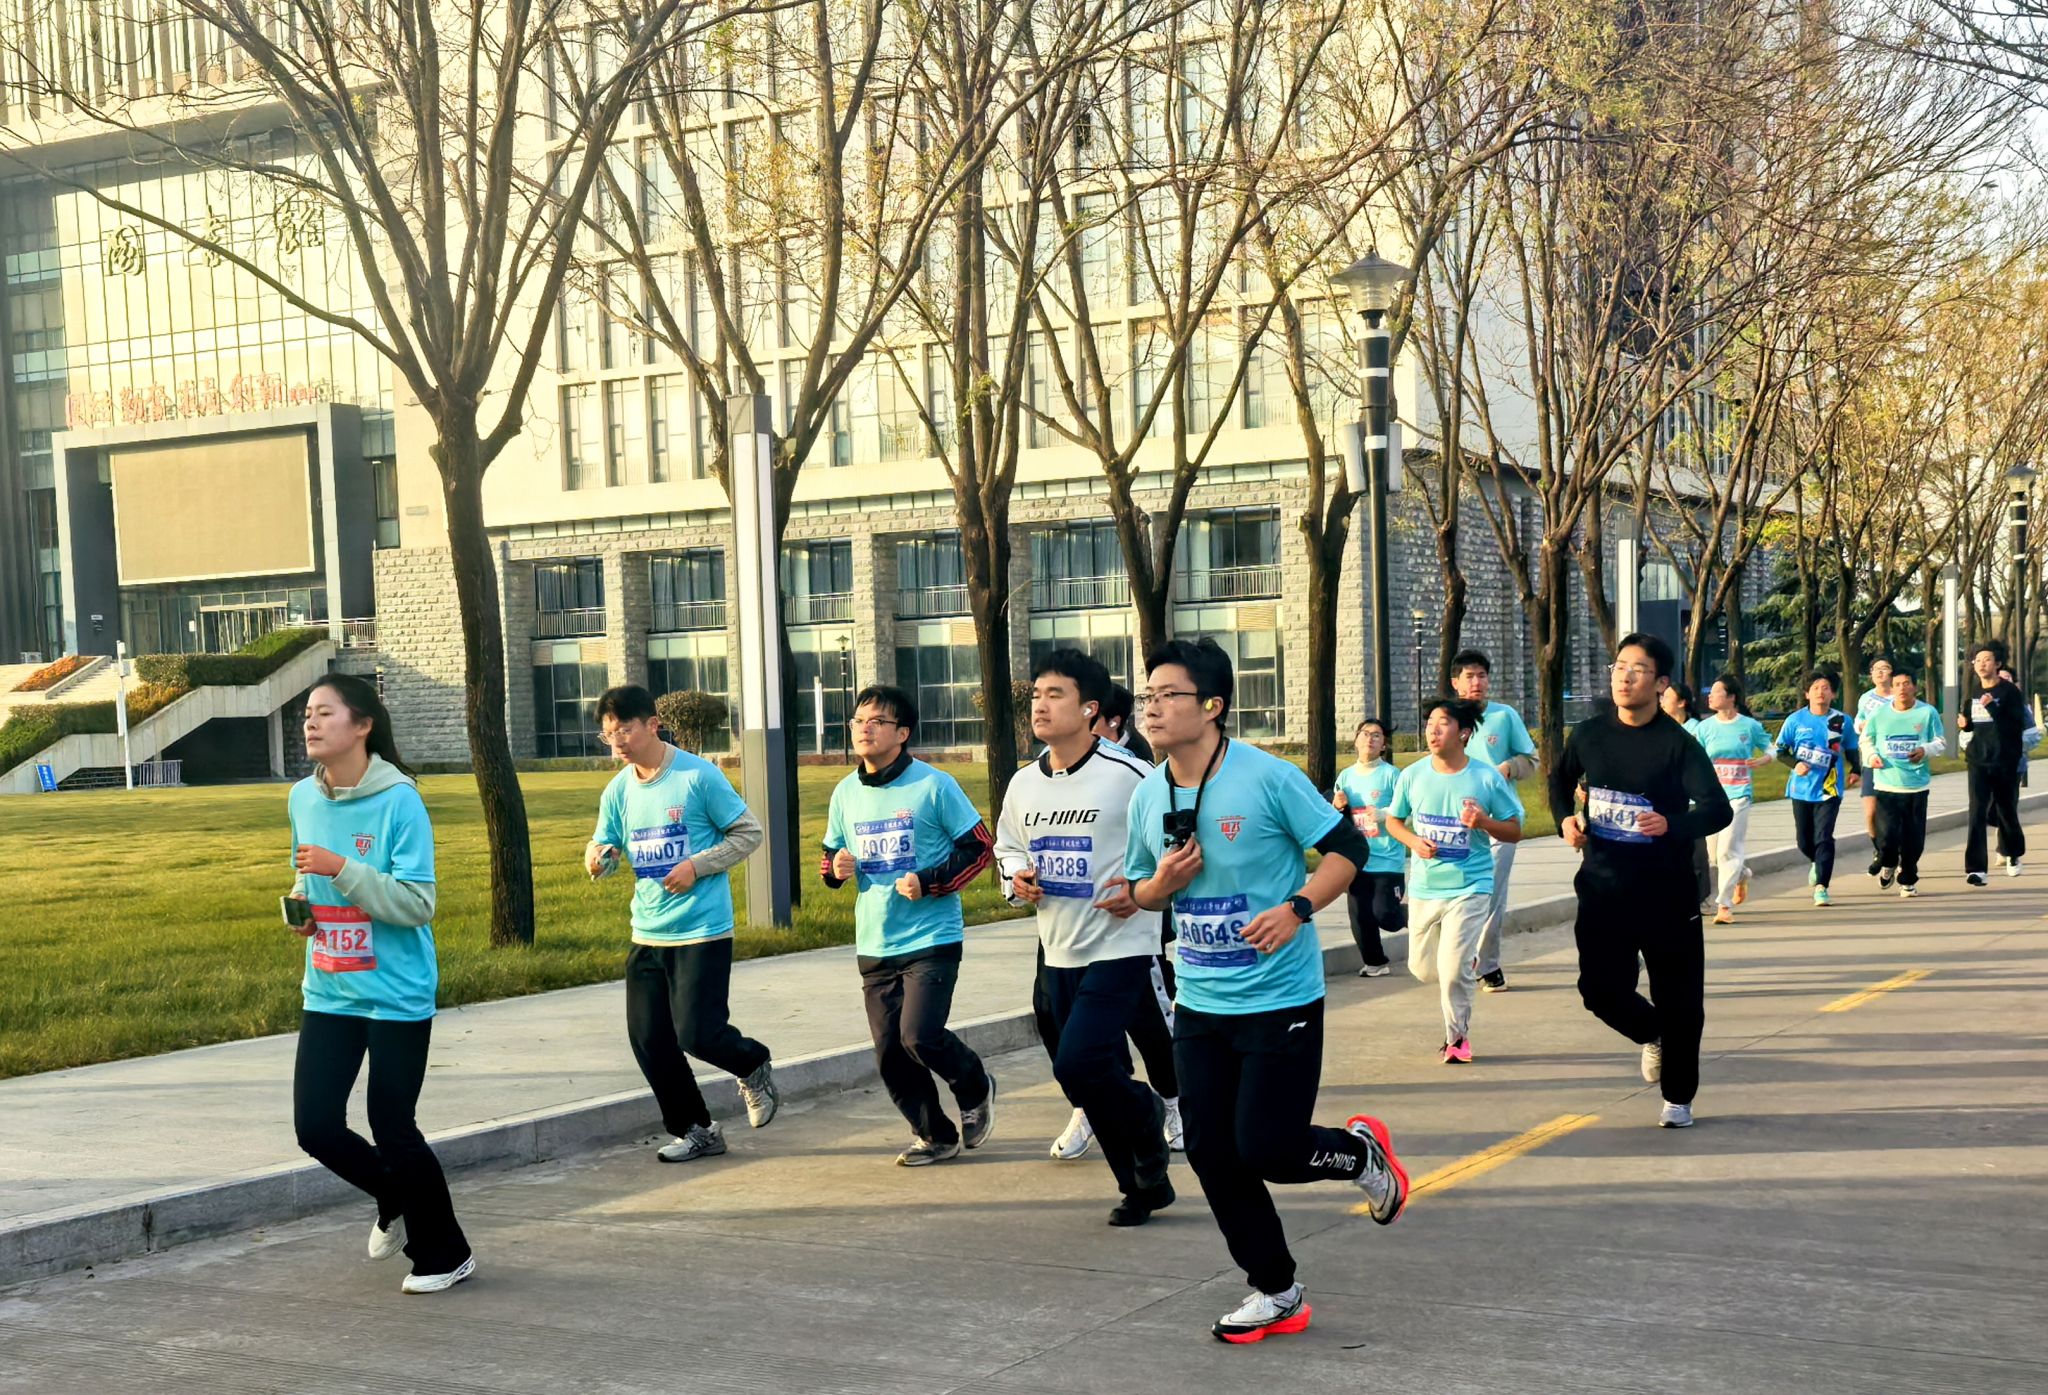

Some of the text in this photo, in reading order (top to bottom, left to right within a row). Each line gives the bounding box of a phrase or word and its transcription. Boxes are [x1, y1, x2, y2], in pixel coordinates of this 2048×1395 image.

[1025, 809, 1100, 827] LI-NING
[635, 840, 685, 863] A0007
[862, 834, 911, 860] A0025
[1037, 853, 1088, 878] A0389
[1309, 1150, 1357, 1172] LI-NING
